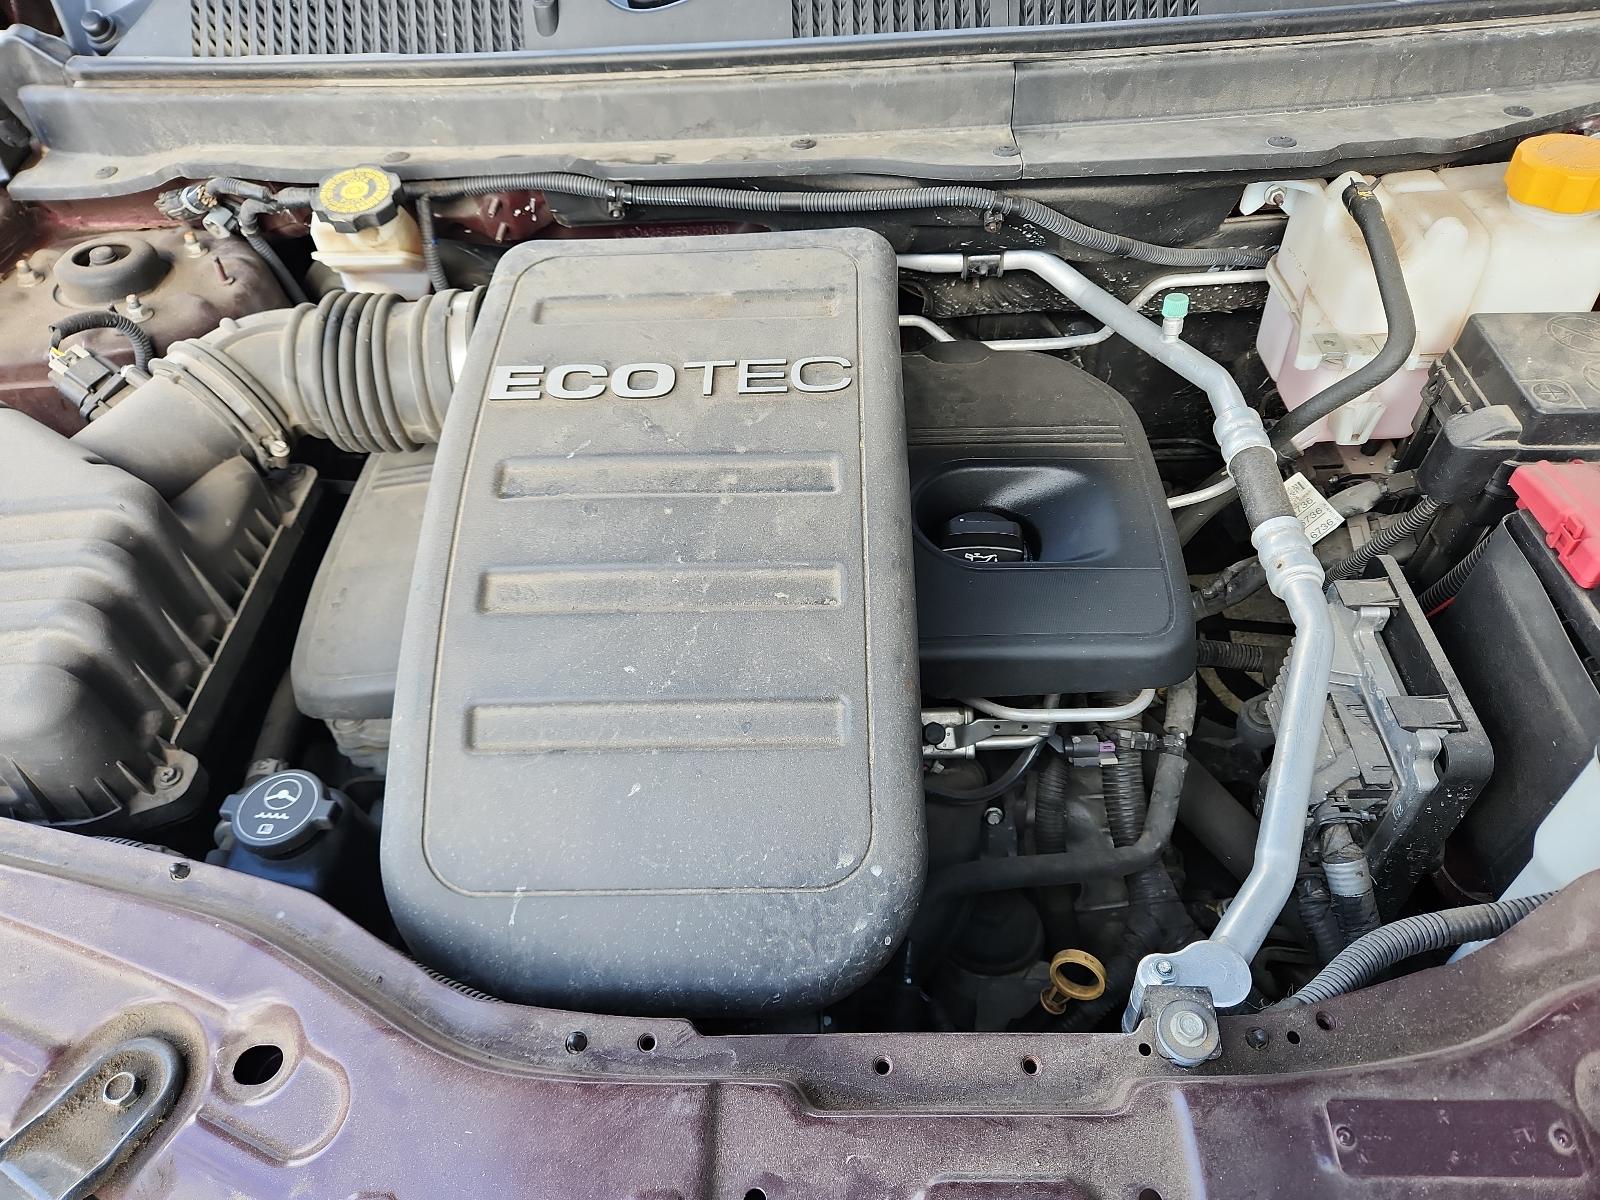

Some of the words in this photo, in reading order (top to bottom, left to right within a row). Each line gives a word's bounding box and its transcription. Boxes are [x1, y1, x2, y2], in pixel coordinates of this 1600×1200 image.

[488, 355, 853, 400] ECOTEC
[1295, 497, 1314, 513] 736
[1310, 518, 1334, 540] 6736
